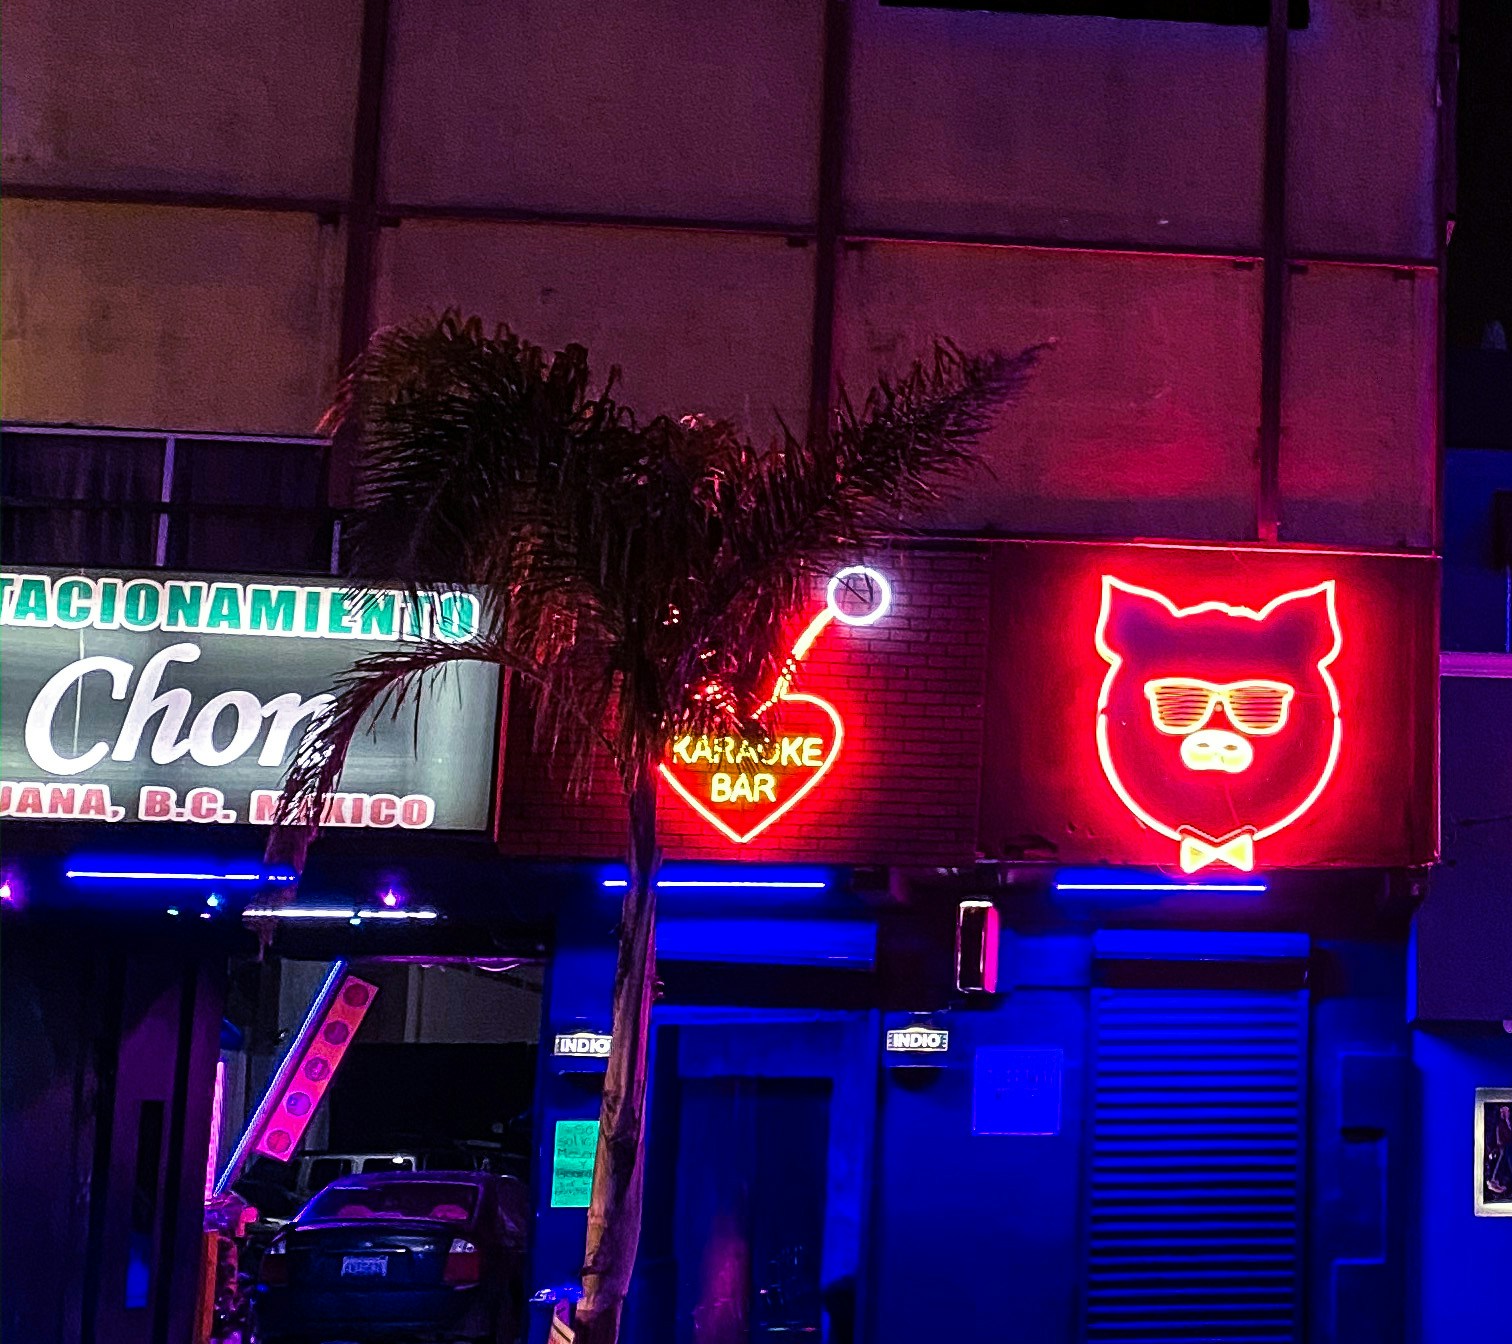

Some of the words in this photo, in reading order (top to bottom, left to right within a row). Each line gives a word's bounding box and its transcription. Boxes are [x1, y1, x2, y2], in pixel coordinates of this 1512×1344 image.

[711, 772, 777, 803] BAR
[139, 786, 237, 823] B.C.
[250, 790, 434, 829] MXICO
[560, 1038, 611, 1054] INDIO
[892, 1032, 941, 1048] INDIO
